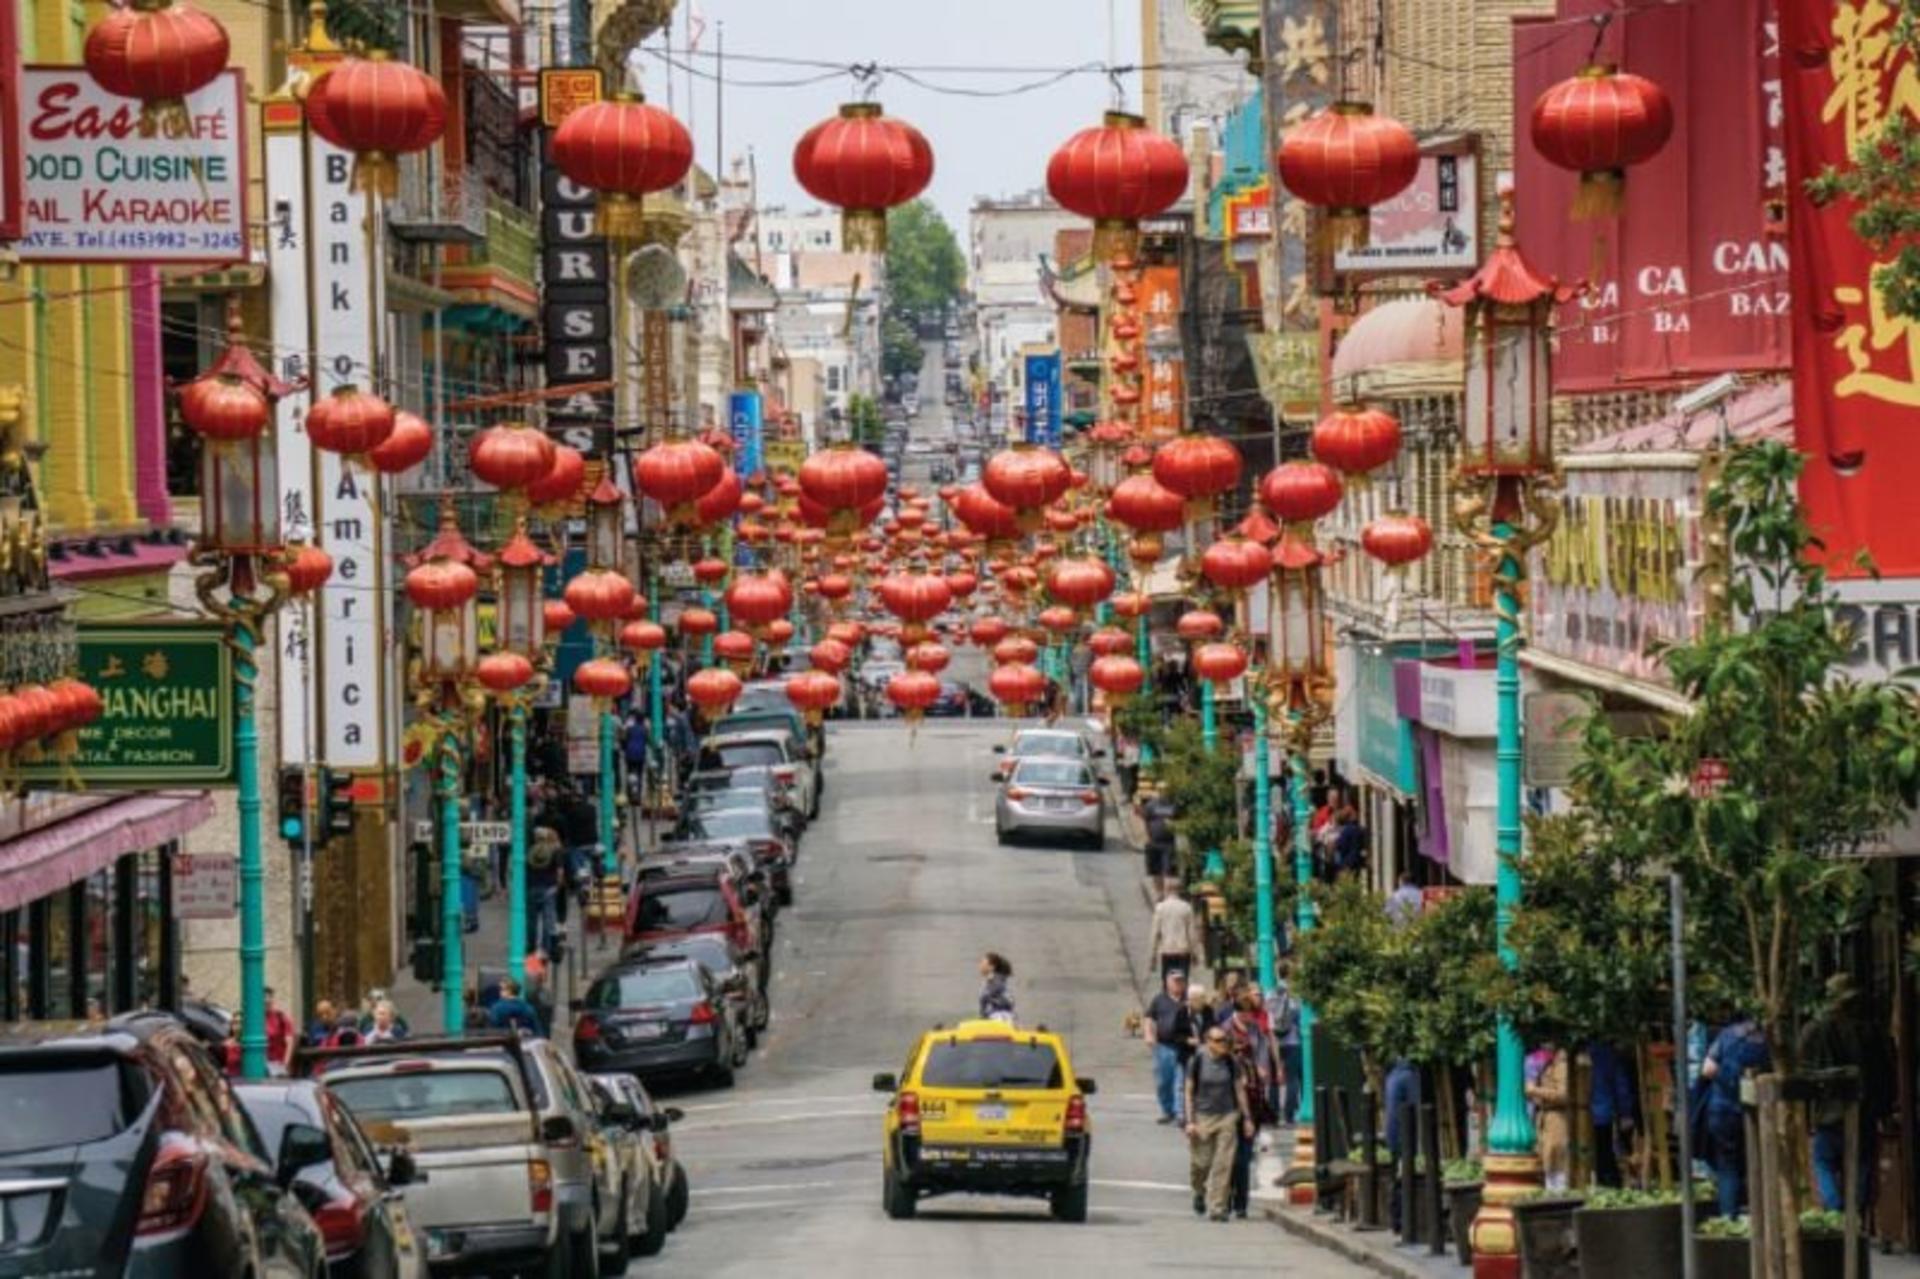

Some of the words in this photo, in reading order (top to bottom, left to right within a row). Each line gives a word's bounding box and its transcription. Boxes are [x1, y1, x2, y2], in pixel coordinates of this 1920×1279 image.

[30, 83, 156, 140] Eas
[96, 146, 227, 183] CUISINE
[83, 188, 231, 225] KARAOKE
[326, 154, 352, 311] Bank
[556, 175, 596, 280] OUR
[1637, 266, 1687, 295] CA
[1655, 312, 1690, 333] BA
[334, 354, 352, 376] o
[333, 472, 362, 745] America
[98, 685, 217, 718] HANGHAI
